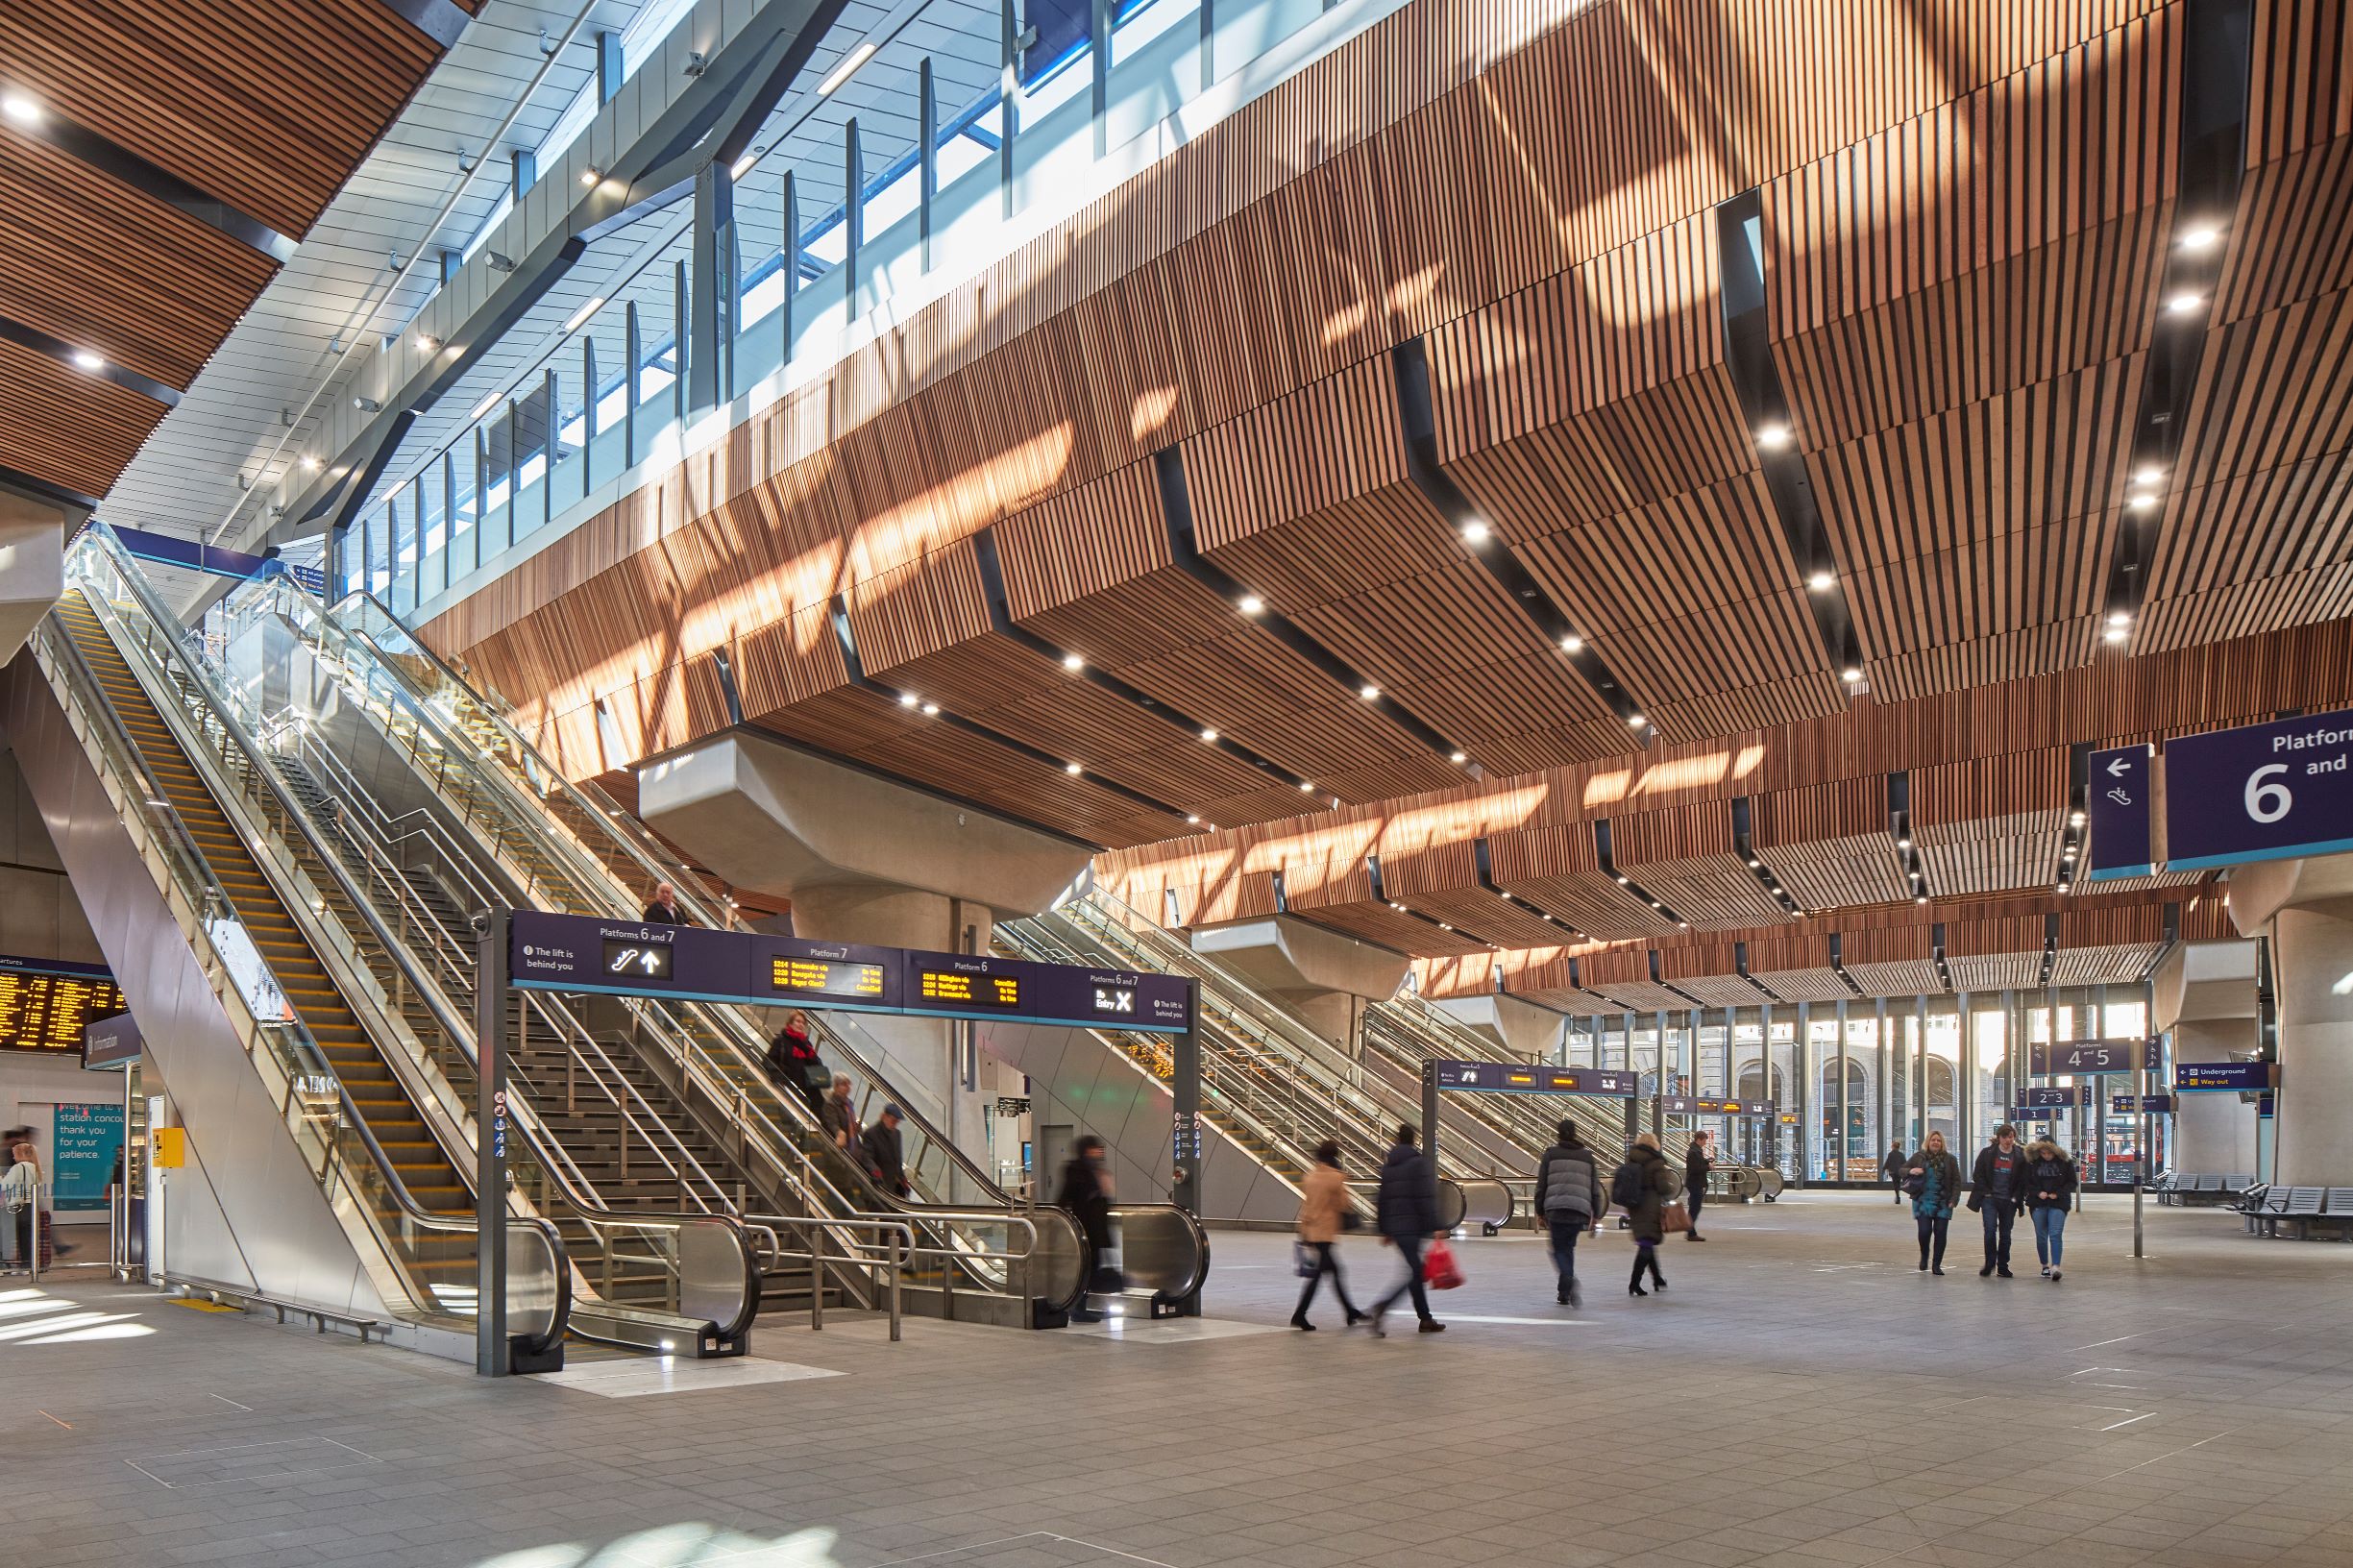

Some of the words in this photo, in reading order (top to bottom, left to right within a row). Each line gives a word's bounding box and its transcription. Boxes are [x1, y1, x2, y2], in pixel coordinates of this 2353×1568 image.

[2273, 729, 2353, 752] Platfor
[2244, 763, 2292, 824] 6
[2306, 753, 2347, 775] and
[600, 927, 639, 940] Platforms
[640, 928, 649, 940] 6
[650, 933, 665, 942] and
[667, 931, 675, 942] 7
[535, 947, 551, 957] The
[552, 948, 564, 958] lift
[566, 950, 574, 959] is
[810, 948, 839, 958] Platform
[840, 948, 847, 958] 7
[527, 959, 556, 970] behind
[557, 963, 574, 971] you
[955, 962, 980, 971] Platform
[981, 962, 988, 972] 6
[1090, 975, 1115, 983] Platforms
[1116, 974, 1121, 984] 6
[1133, 976, 1138, 985] 7
[1096, 990, 1105, 999] No
[1096, 999, 1115, 1009] Entry
[2068, 1051, 2082, 1066] 4
[2097, 1050, 2109, 1065] 5
[2039, 1094, 2047, 1103] 2
[2055, 1093, 2063, 1103] 3
[60, 1114, 92, 1122] station
[60, 1126, 86, 1134] thank
[60, 1138, 74, 1146] for
[59, 1150, 99, 1159] patience.
